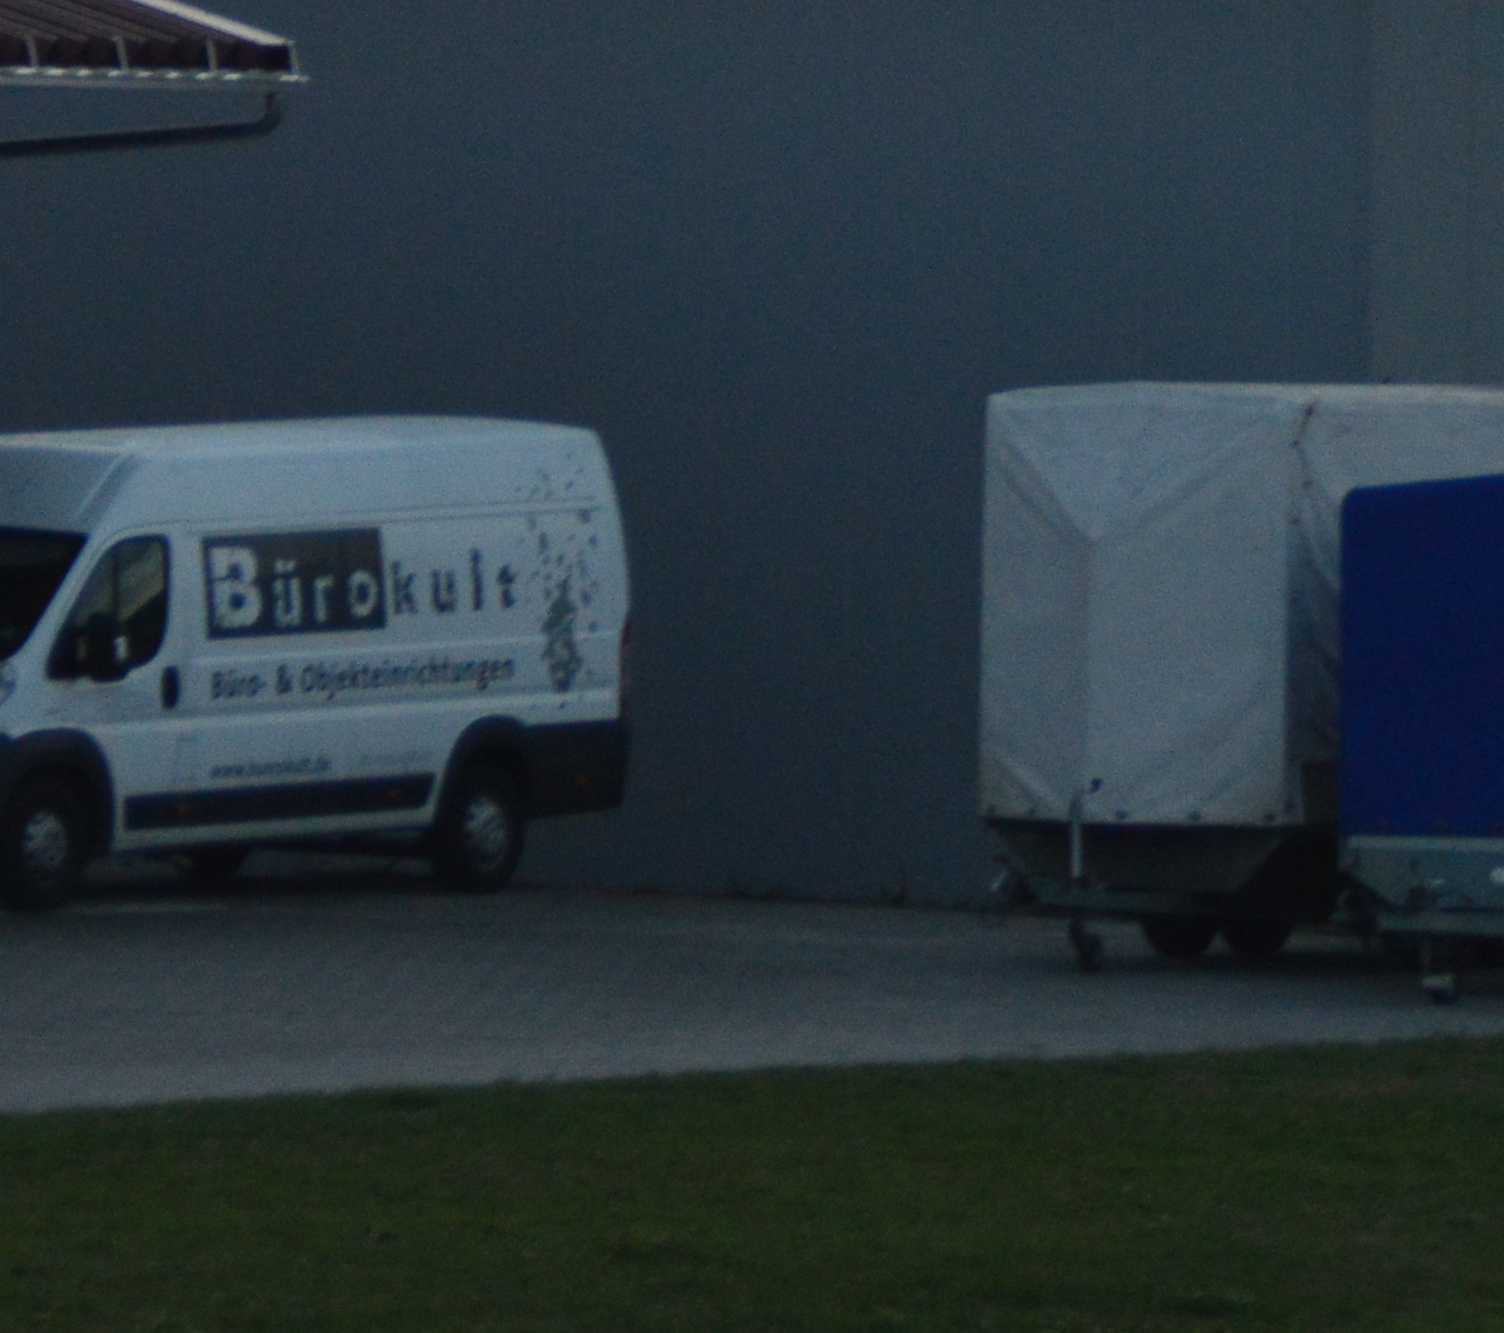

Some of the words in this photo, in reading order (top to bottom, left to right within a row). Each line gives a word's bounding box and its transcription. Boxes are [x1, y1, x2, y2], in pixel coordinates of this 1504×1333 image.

[208, 544, 518, 629] Bürokult
[211, 670, 267, 700] Büro-
[275, 662, 293, 694] &
[300, 657, 514, 701] Objekteinrichtungen
